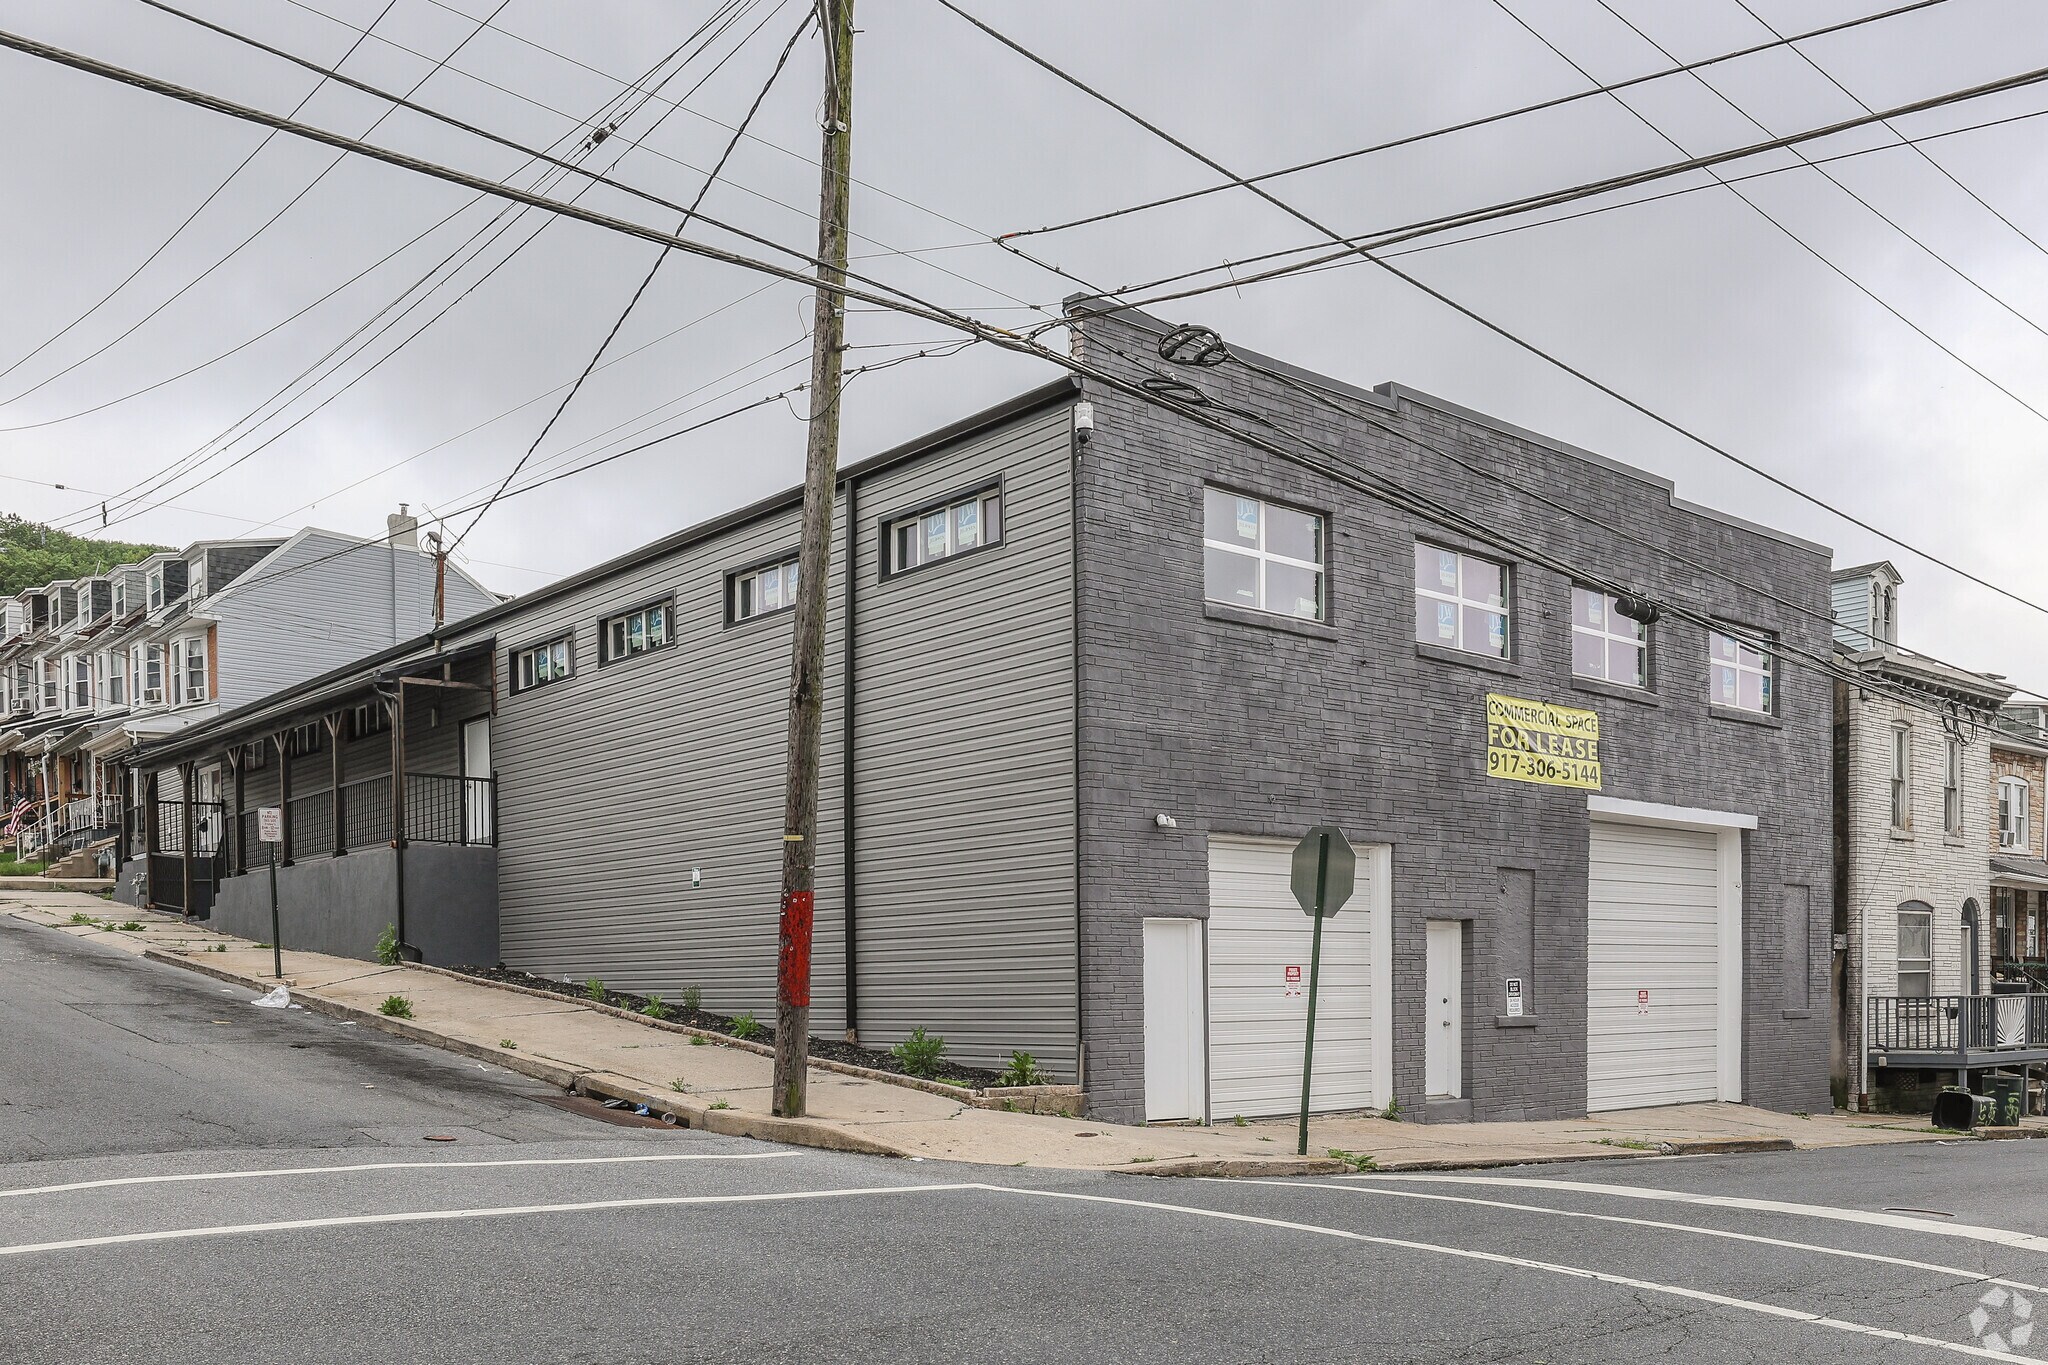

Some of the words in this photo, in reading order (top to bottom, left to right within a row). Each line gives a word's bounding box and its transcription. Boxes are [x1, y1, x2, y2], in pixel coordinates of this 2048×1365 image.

[1488, 701, 1561, 727] COMMERCIAL
[1566, 714, 1597, 733] SPACE
[1488, 725, 1530, 751] FOR
[1536, 733, 1599, 761] LEASE
[1489, 752, 1598, 783] 917-306-5144
